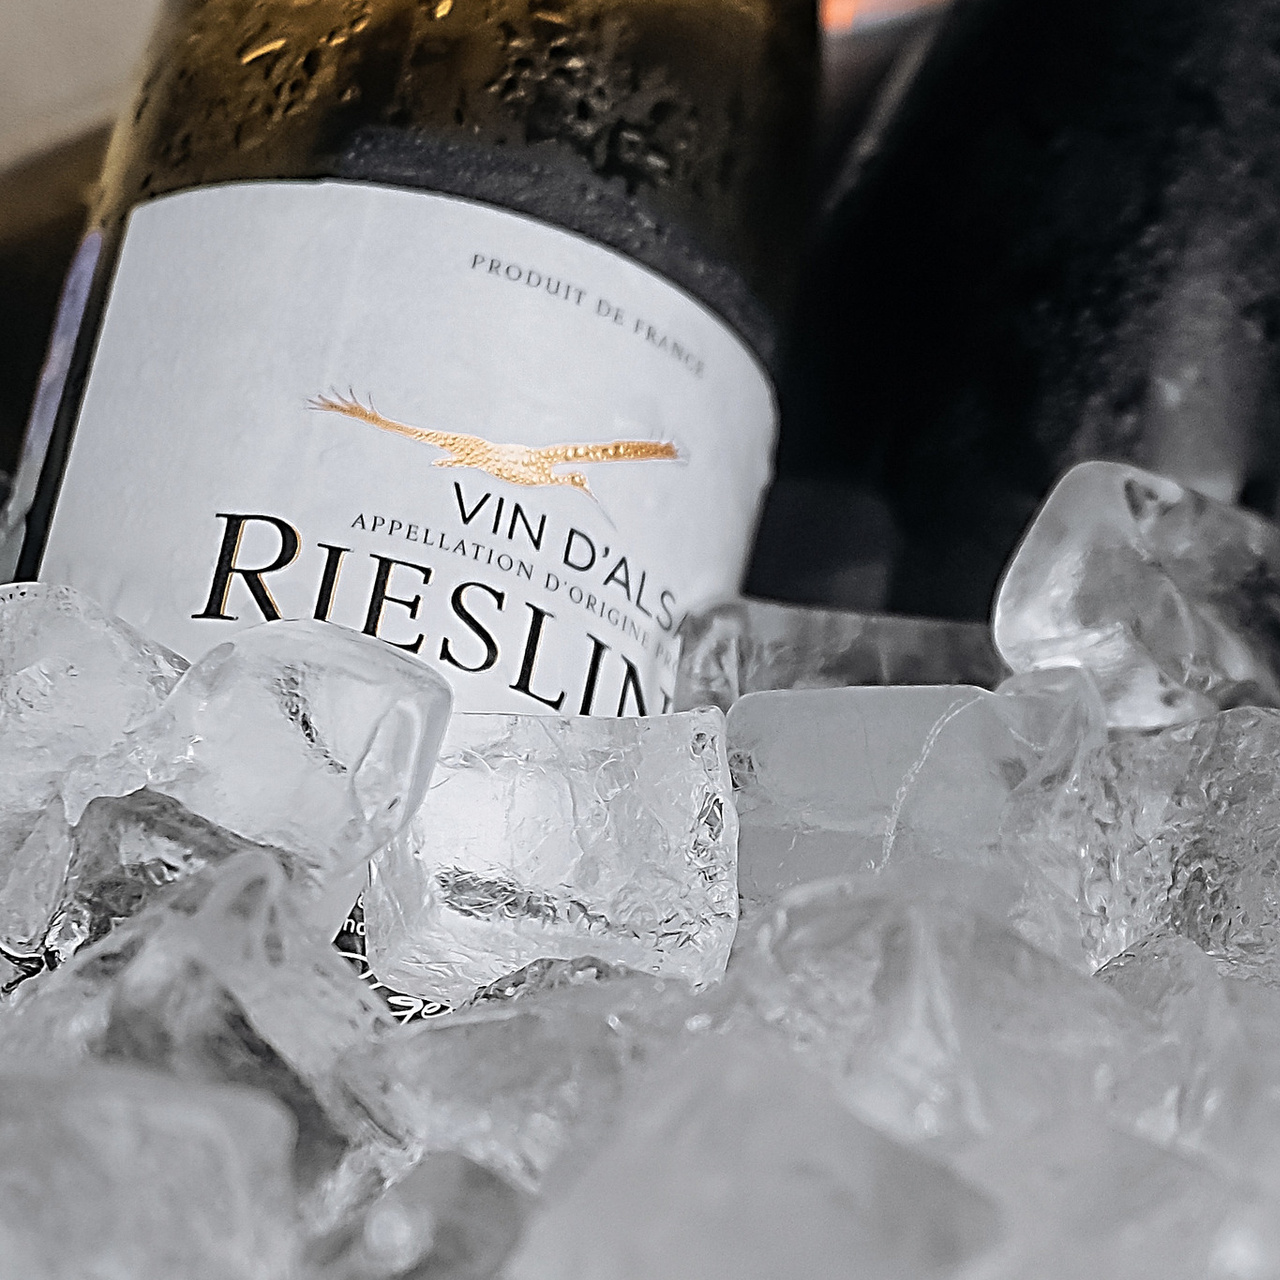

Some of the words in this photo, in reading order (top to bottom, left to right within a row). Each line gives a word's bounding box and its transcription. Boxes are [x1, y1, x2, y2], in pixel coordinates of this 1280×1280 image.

[470, 252, 588, 307] PRODUIT
[596, 298, 627, 326] DE
[633, 318, 706, 380] FRANCE
[350, 512, 536, 583] APPELLATION
[453, 480, 548, 552] VIN
